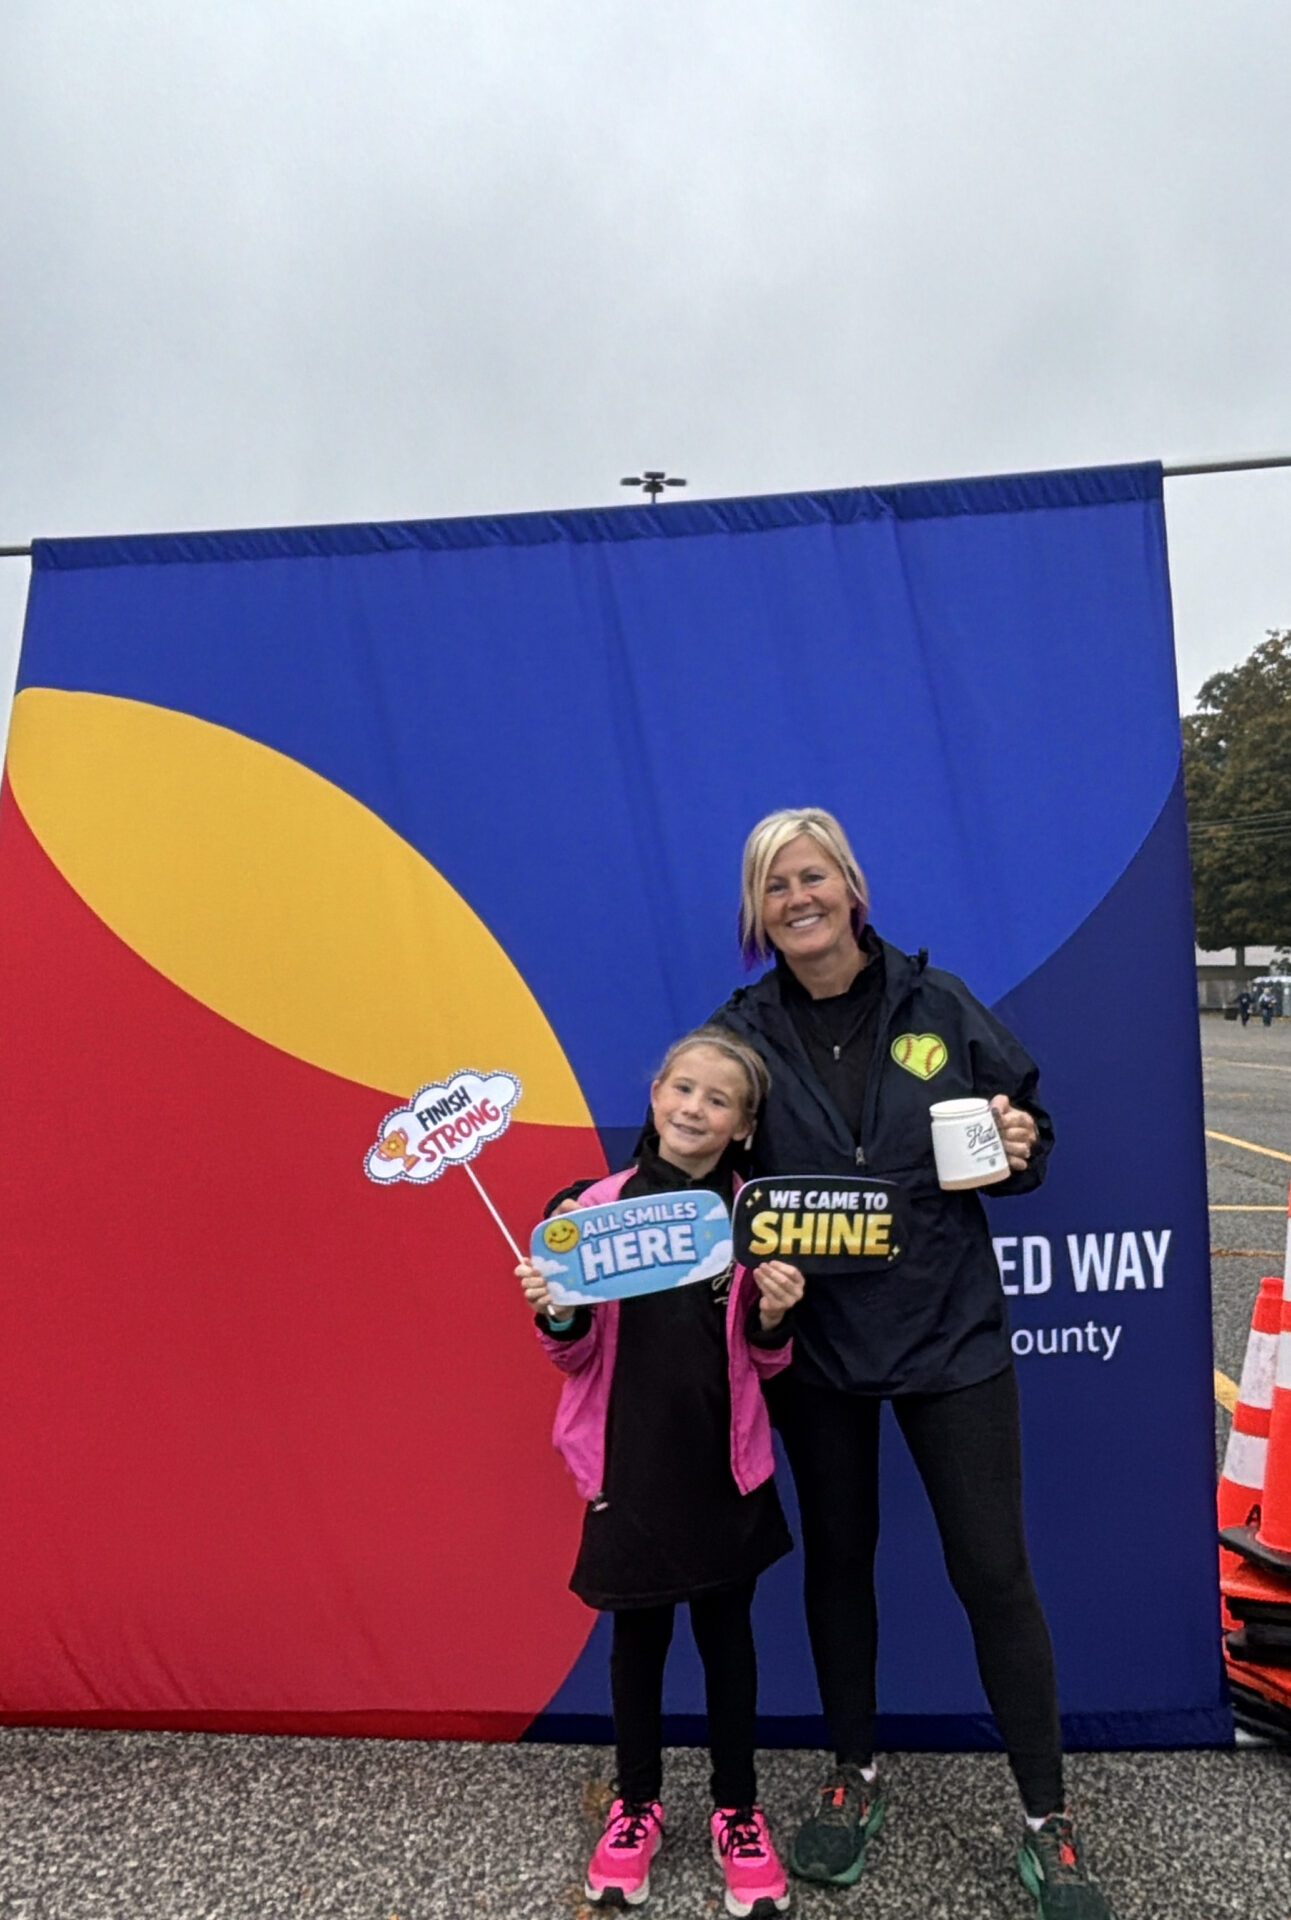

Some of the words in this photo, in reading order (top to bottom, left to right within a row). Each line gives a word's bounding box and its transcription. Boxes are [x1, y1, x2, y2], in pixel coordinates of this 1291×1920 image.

[415, 1085, 473, 1132] FINISH
[417, 1098, 501, 1163] STRONG
[582, 1214, 622, 1239] ALL
[623, 1202, 698, 1229] SMILES
[769, 1190, 802, 1209] WE
[803, 1190, 860, 1210] CAME
[863, 1192, 889, 1211] TO
[579, 1223, 698, 1283] HERE
[749, 1210, 893, 1256] SHINE
[1066, 1229, 1172, 1293] WAY
